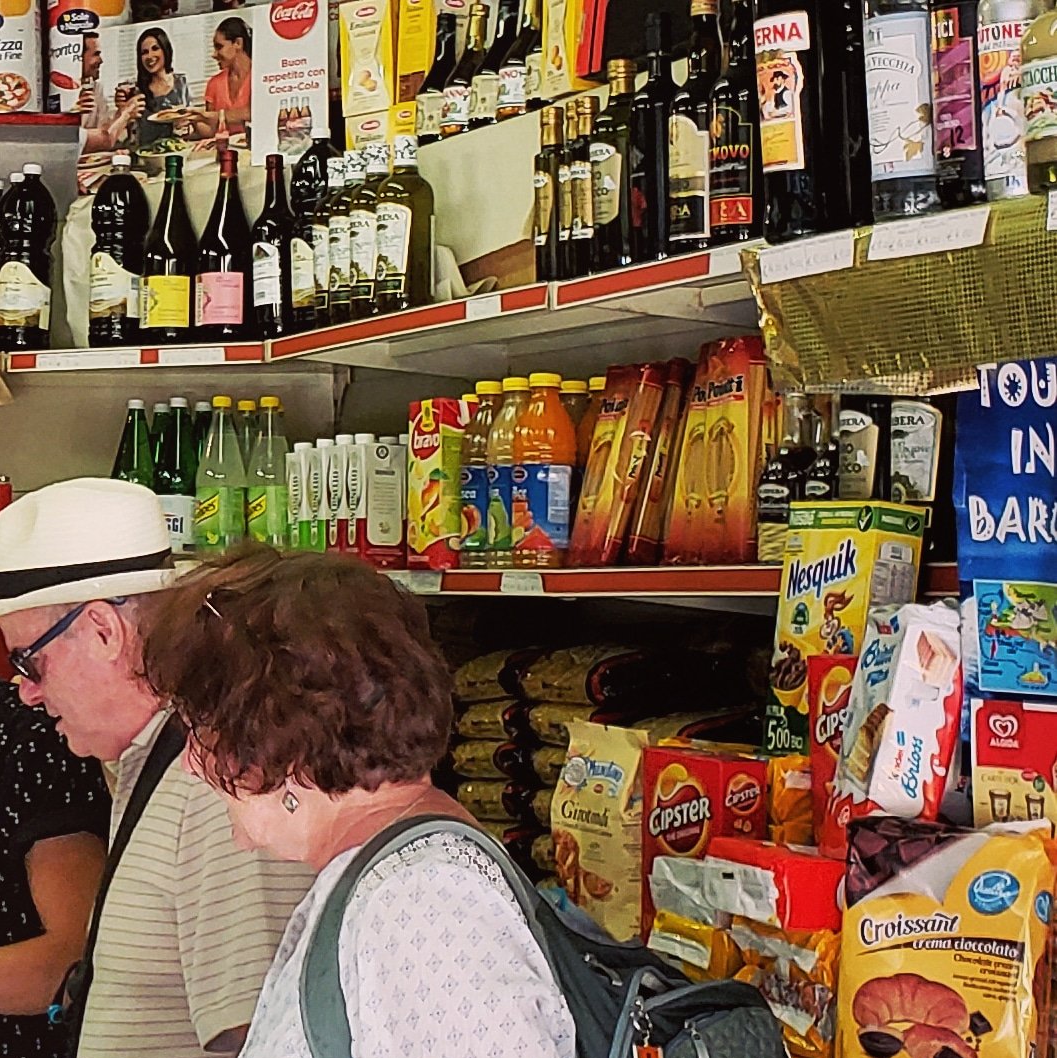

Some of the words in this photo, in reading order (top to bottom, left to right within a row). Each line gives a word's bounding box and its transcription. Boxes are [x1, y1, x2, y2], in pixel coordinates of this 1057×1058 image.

[263, 72, 304, 83] appetito
[307, 69, 326, 78] con
[281, 58, 307, 68] Buon
[268, 82, 320, 94] Coca-Cola
[786, 539, 857, 600] Nesquik
[767, 719, 791, 751] 500
[649, 797, 712, 837] CIPSTER
[860, 913, 959, 946] Croissant
[912, 938, 951, 951] crema
[954, 938, 1019, 959] cioccolato
